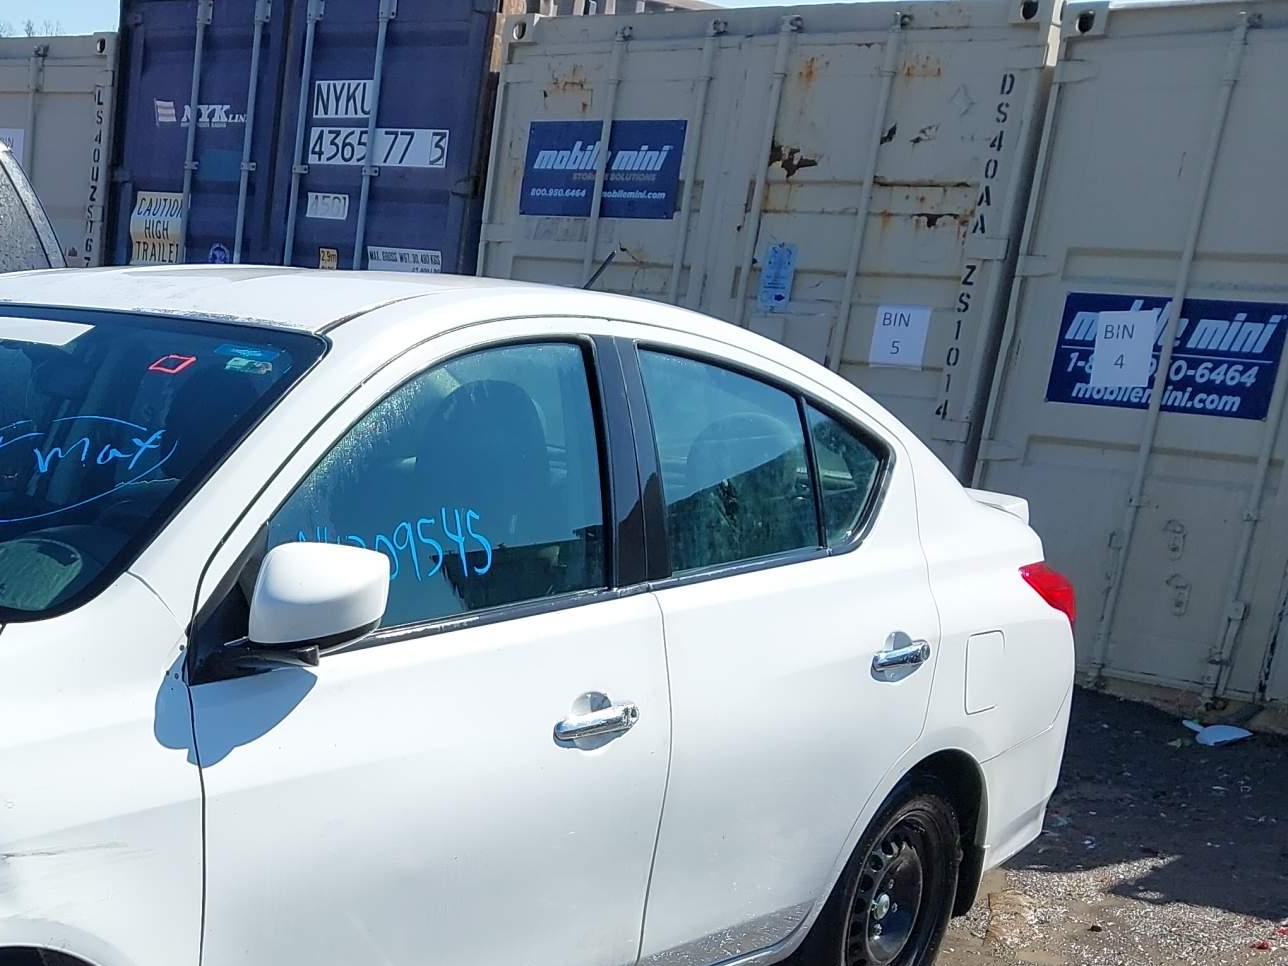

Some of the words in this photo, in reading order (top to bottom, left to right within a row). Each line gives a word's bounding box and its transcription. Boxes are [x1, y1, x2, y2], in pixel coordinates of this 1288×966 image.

[314, 82, 371, 116] NYKU
[612, 145, 671, 171] mini
[144, 219, 170, 240] HIGH
[882, 312, 912, 328] BIN
[1103, 323, 1136, 340] BIN
[1186, 312, 1281, 353] mini
[889, 340, 901, 355] 5
[1113, 353, 1126, 369] 4
